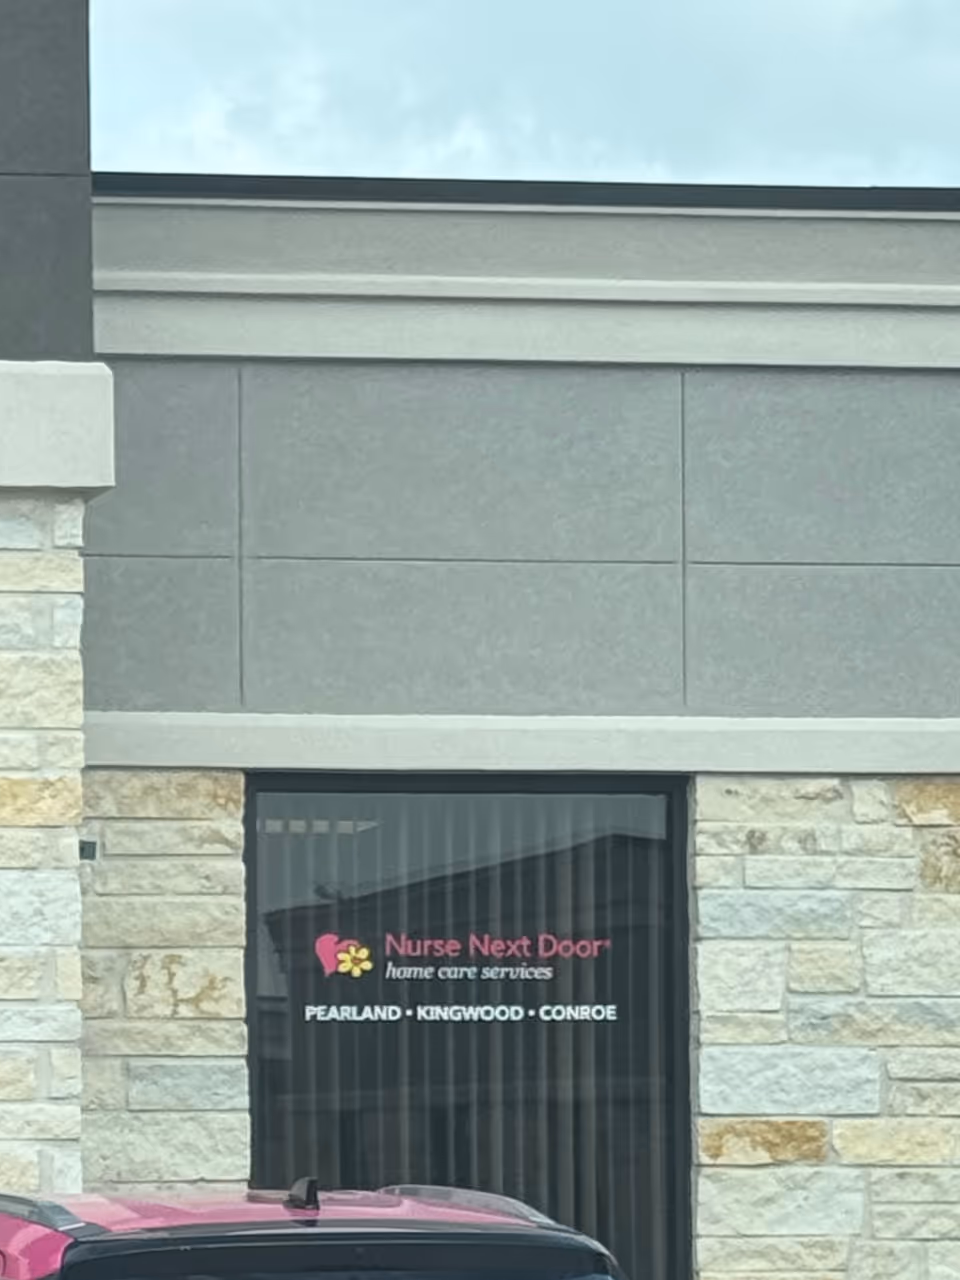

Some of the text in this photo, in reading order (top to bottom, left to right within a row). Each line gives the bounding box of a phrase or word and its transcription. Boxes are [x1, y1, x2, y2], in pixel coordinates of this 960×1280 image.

[385, 933, 602, 958] Nurse Next Door
[385, 962, 554, 979] home care services
[304, 1005, 618, 1022] PEARLAND KINGWOOD CONROE
